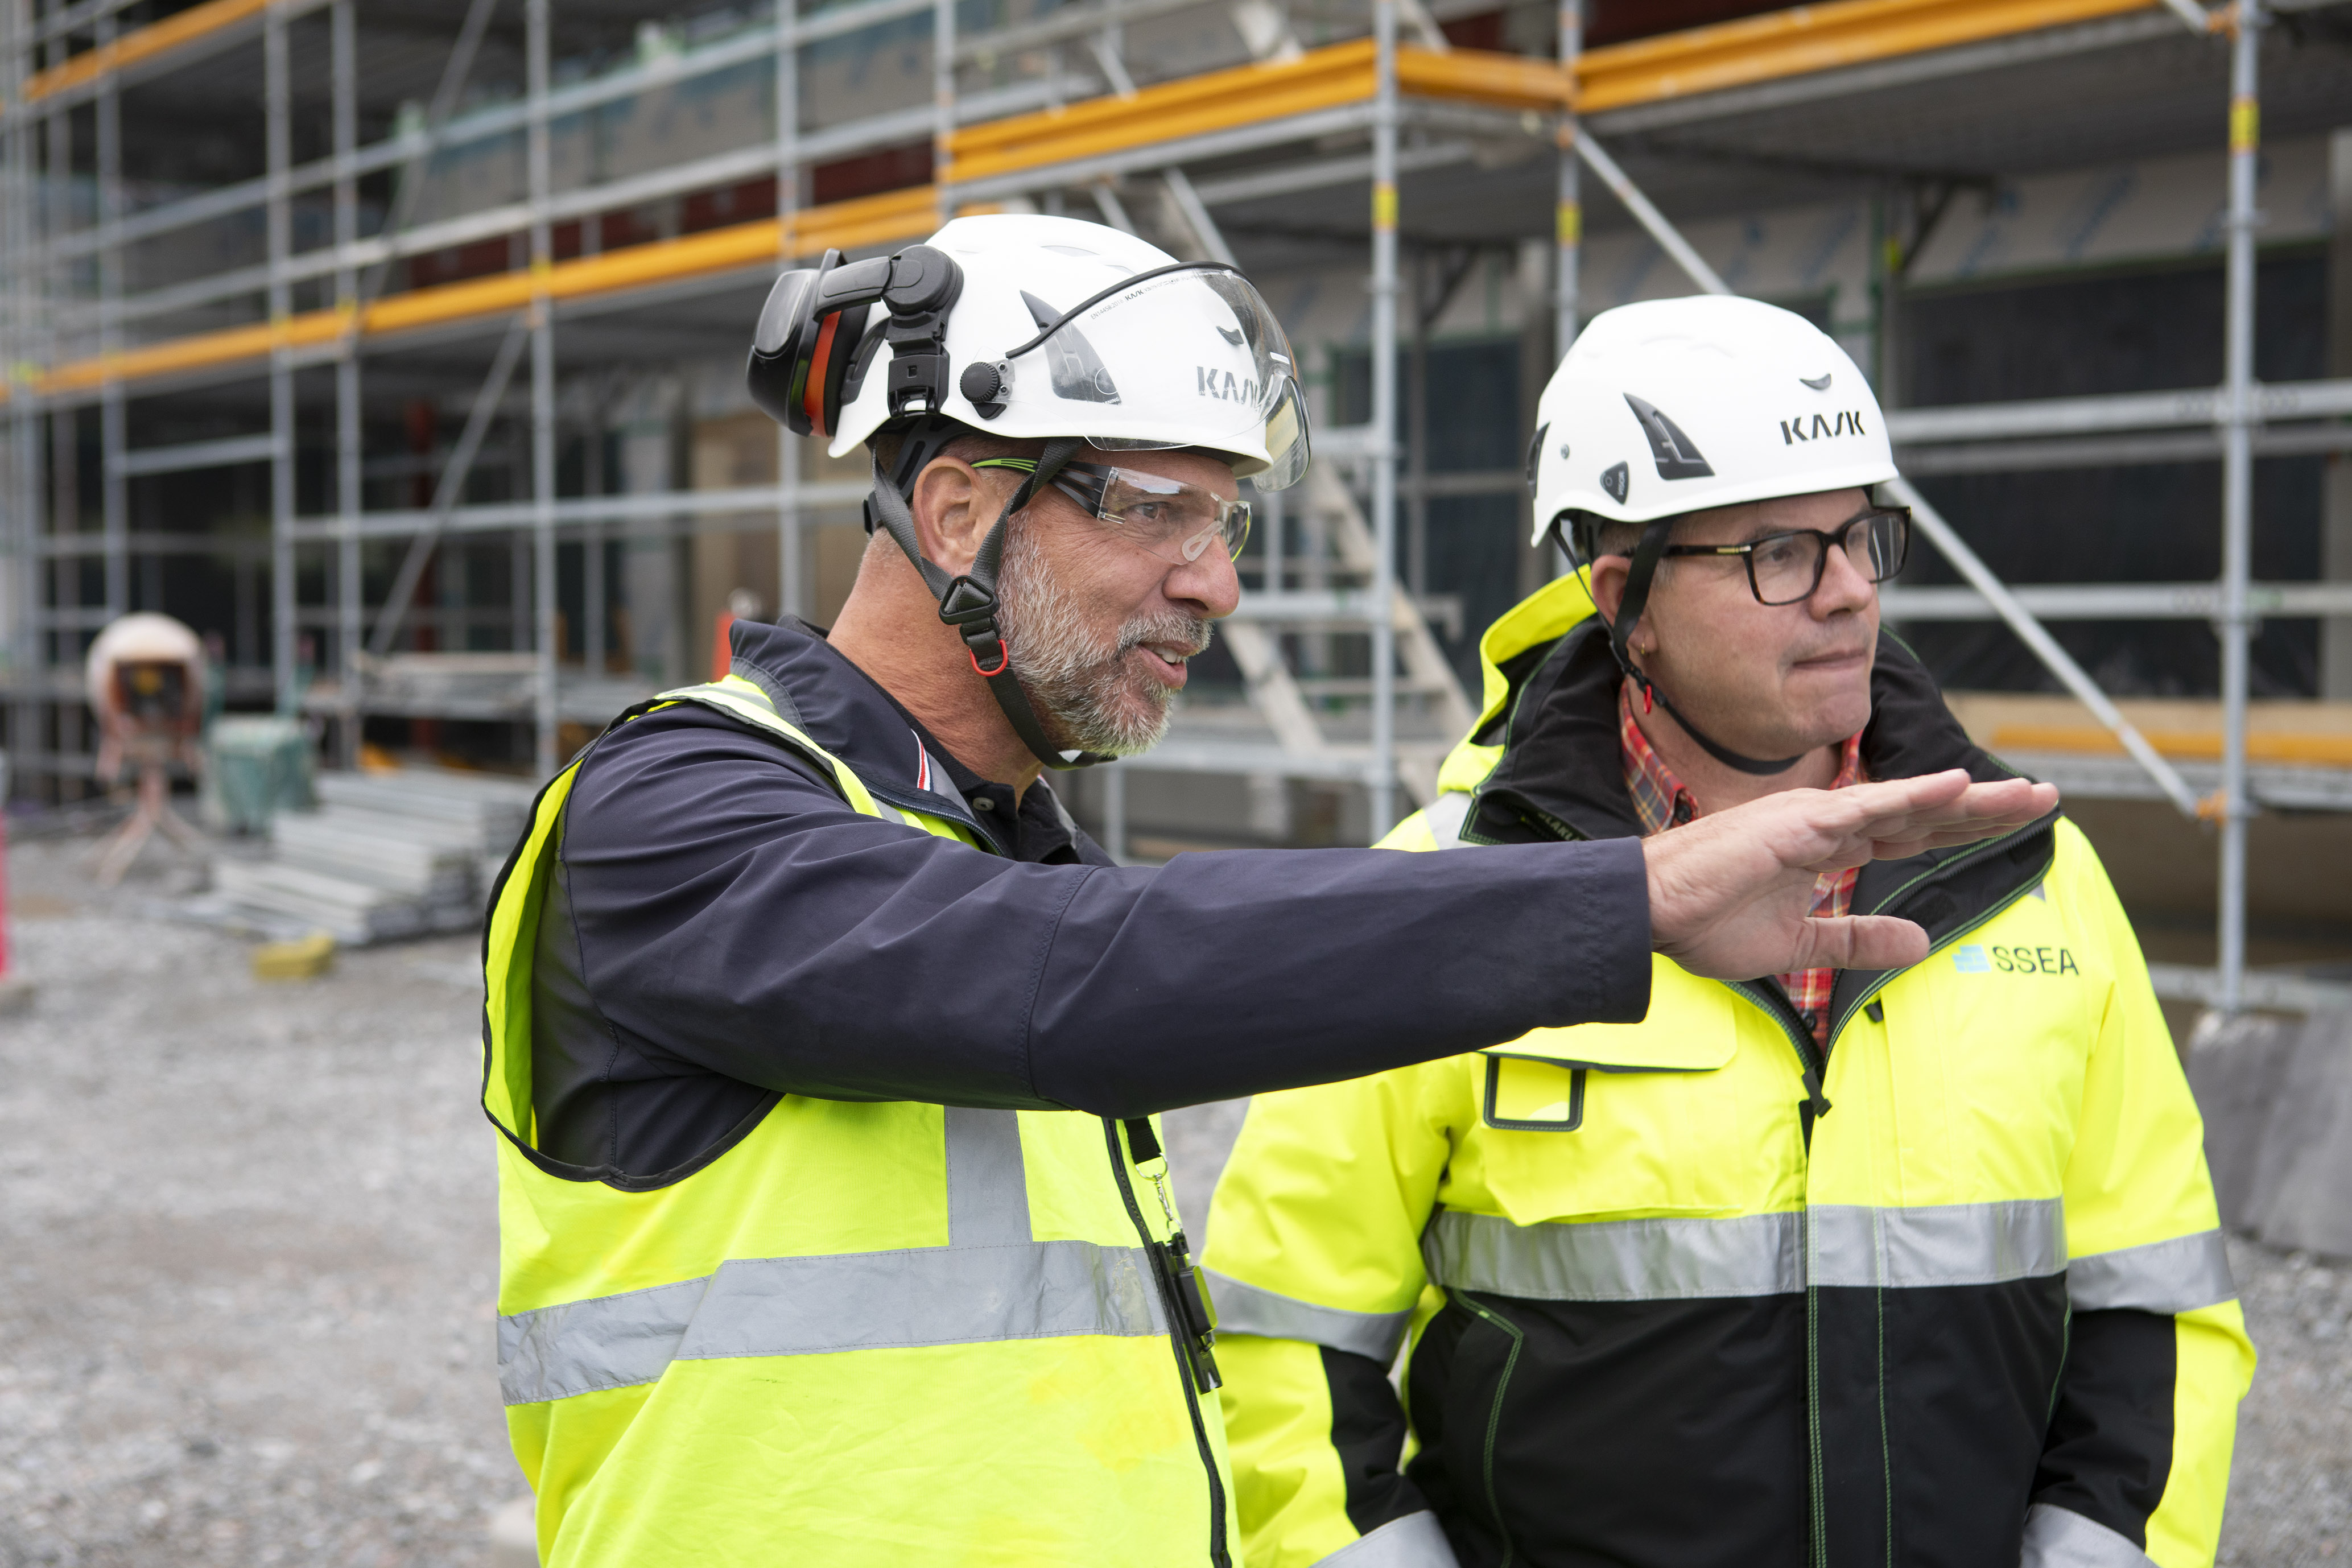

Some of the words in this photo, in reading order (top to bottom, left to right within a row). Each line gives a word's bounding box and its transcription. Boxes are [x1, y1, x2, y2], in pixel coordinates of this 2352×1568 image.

[1124, 288, 1144, 301] KASK
[1780, 410, 1866, 445] KASK
[1992, 946, 2079, 976] SSEA
